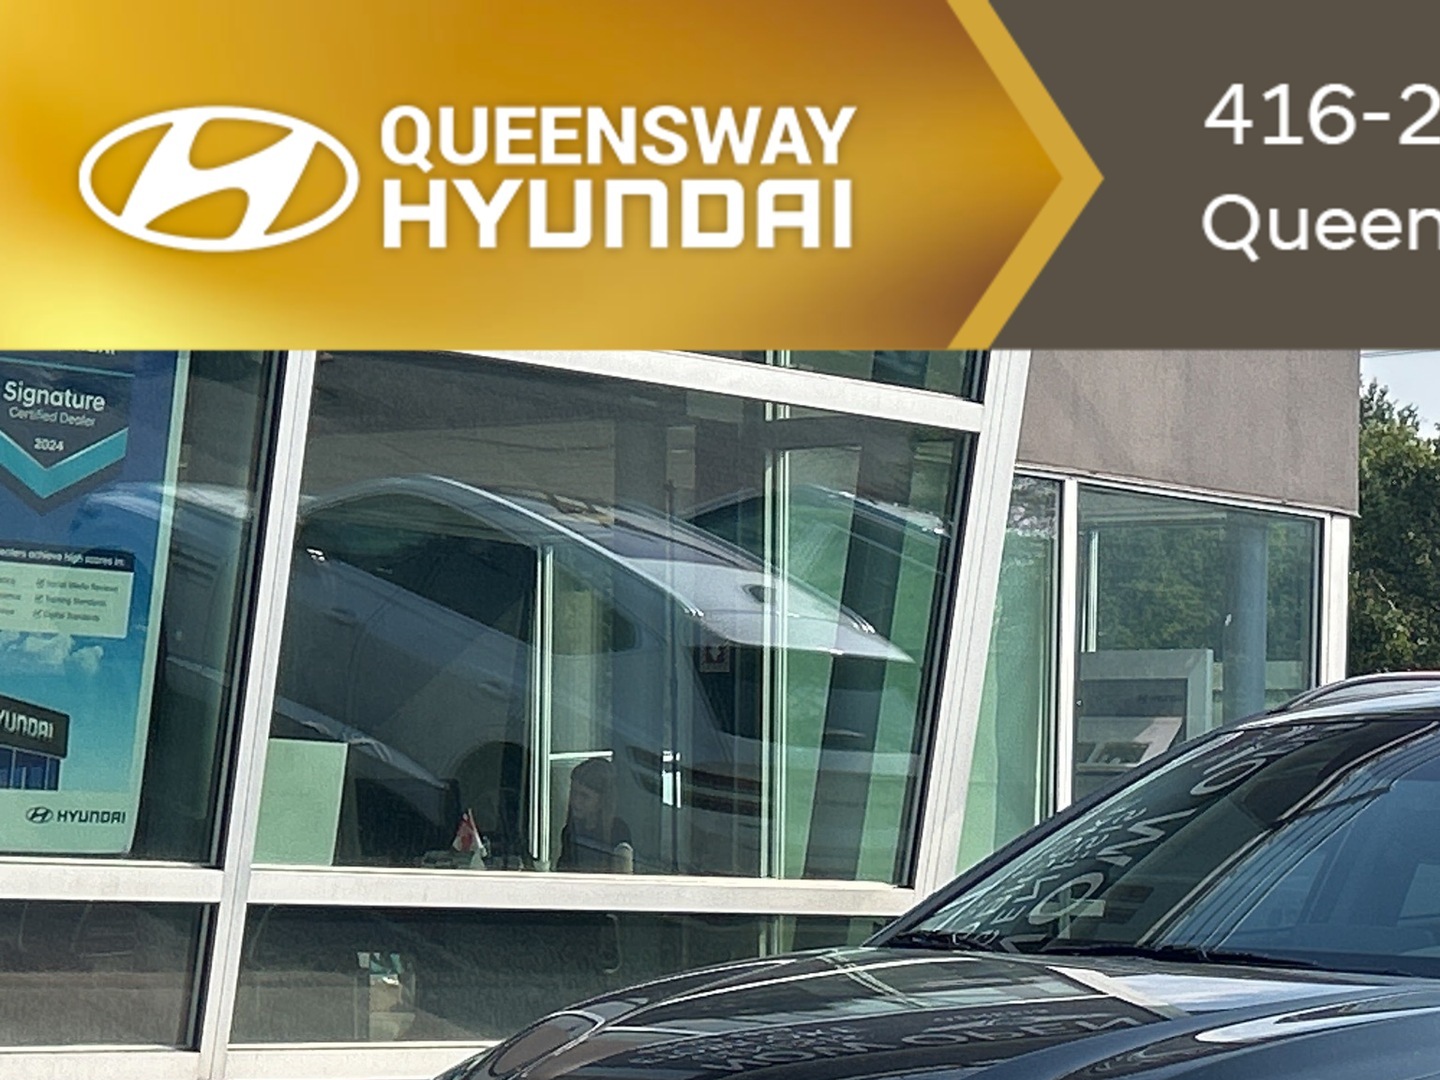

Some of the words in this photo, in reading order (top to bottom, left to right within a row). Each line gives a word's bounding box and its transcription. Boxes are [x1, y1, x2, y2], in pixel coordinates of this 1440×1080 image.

[3, 380, 106, 412] Signature
[34, 437, 64, 451] 2024
[57, 809, 126, 824] HYUNDAI
